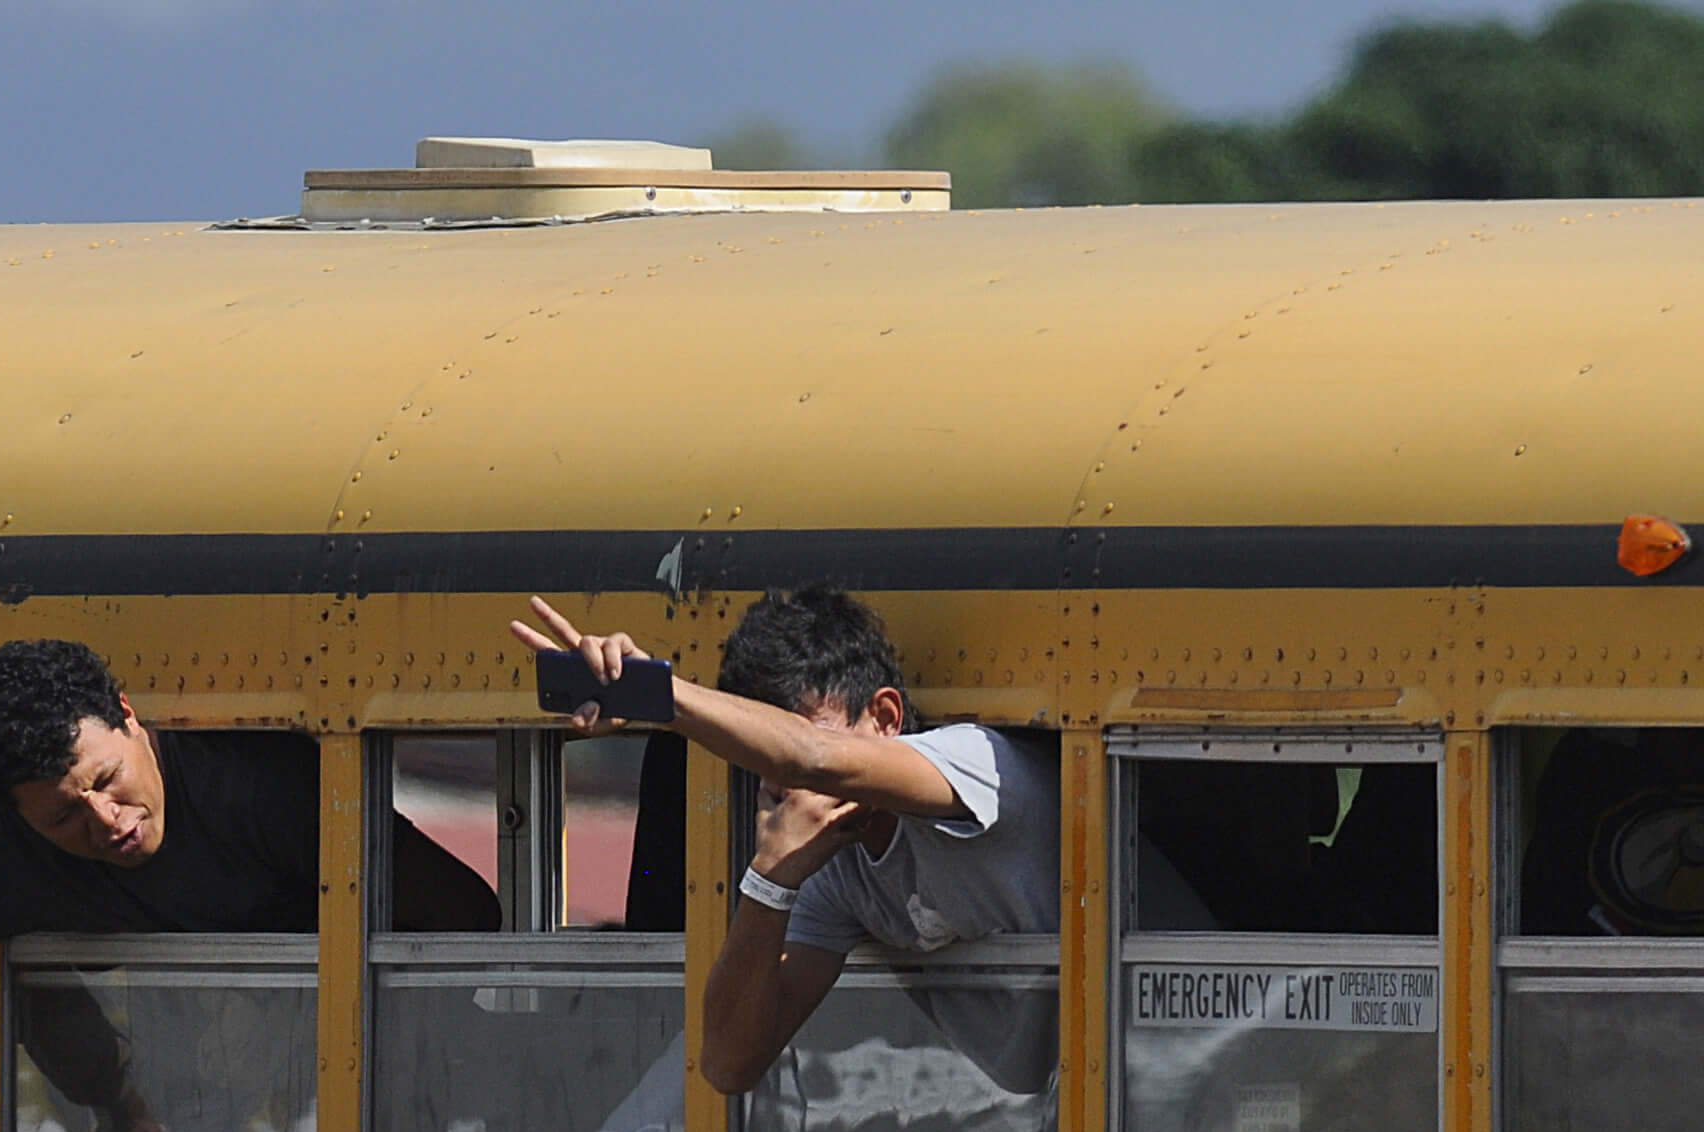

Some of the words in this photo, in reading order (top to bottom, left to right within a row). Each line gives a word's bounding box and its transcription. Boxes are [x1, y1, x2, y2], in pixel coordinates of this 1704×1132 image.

[1138, 972, 1271, 1020] EMERGENCY
[1284, 975, 1335, 1022] EXIT
[1339, 971, 1398, 999] OPERATES
[1401, 973, 1434, 999] FROM
[1351, 1001, 1388, 1025] INSIDE
[1391, 1003, 1423, 1027] ONLY
